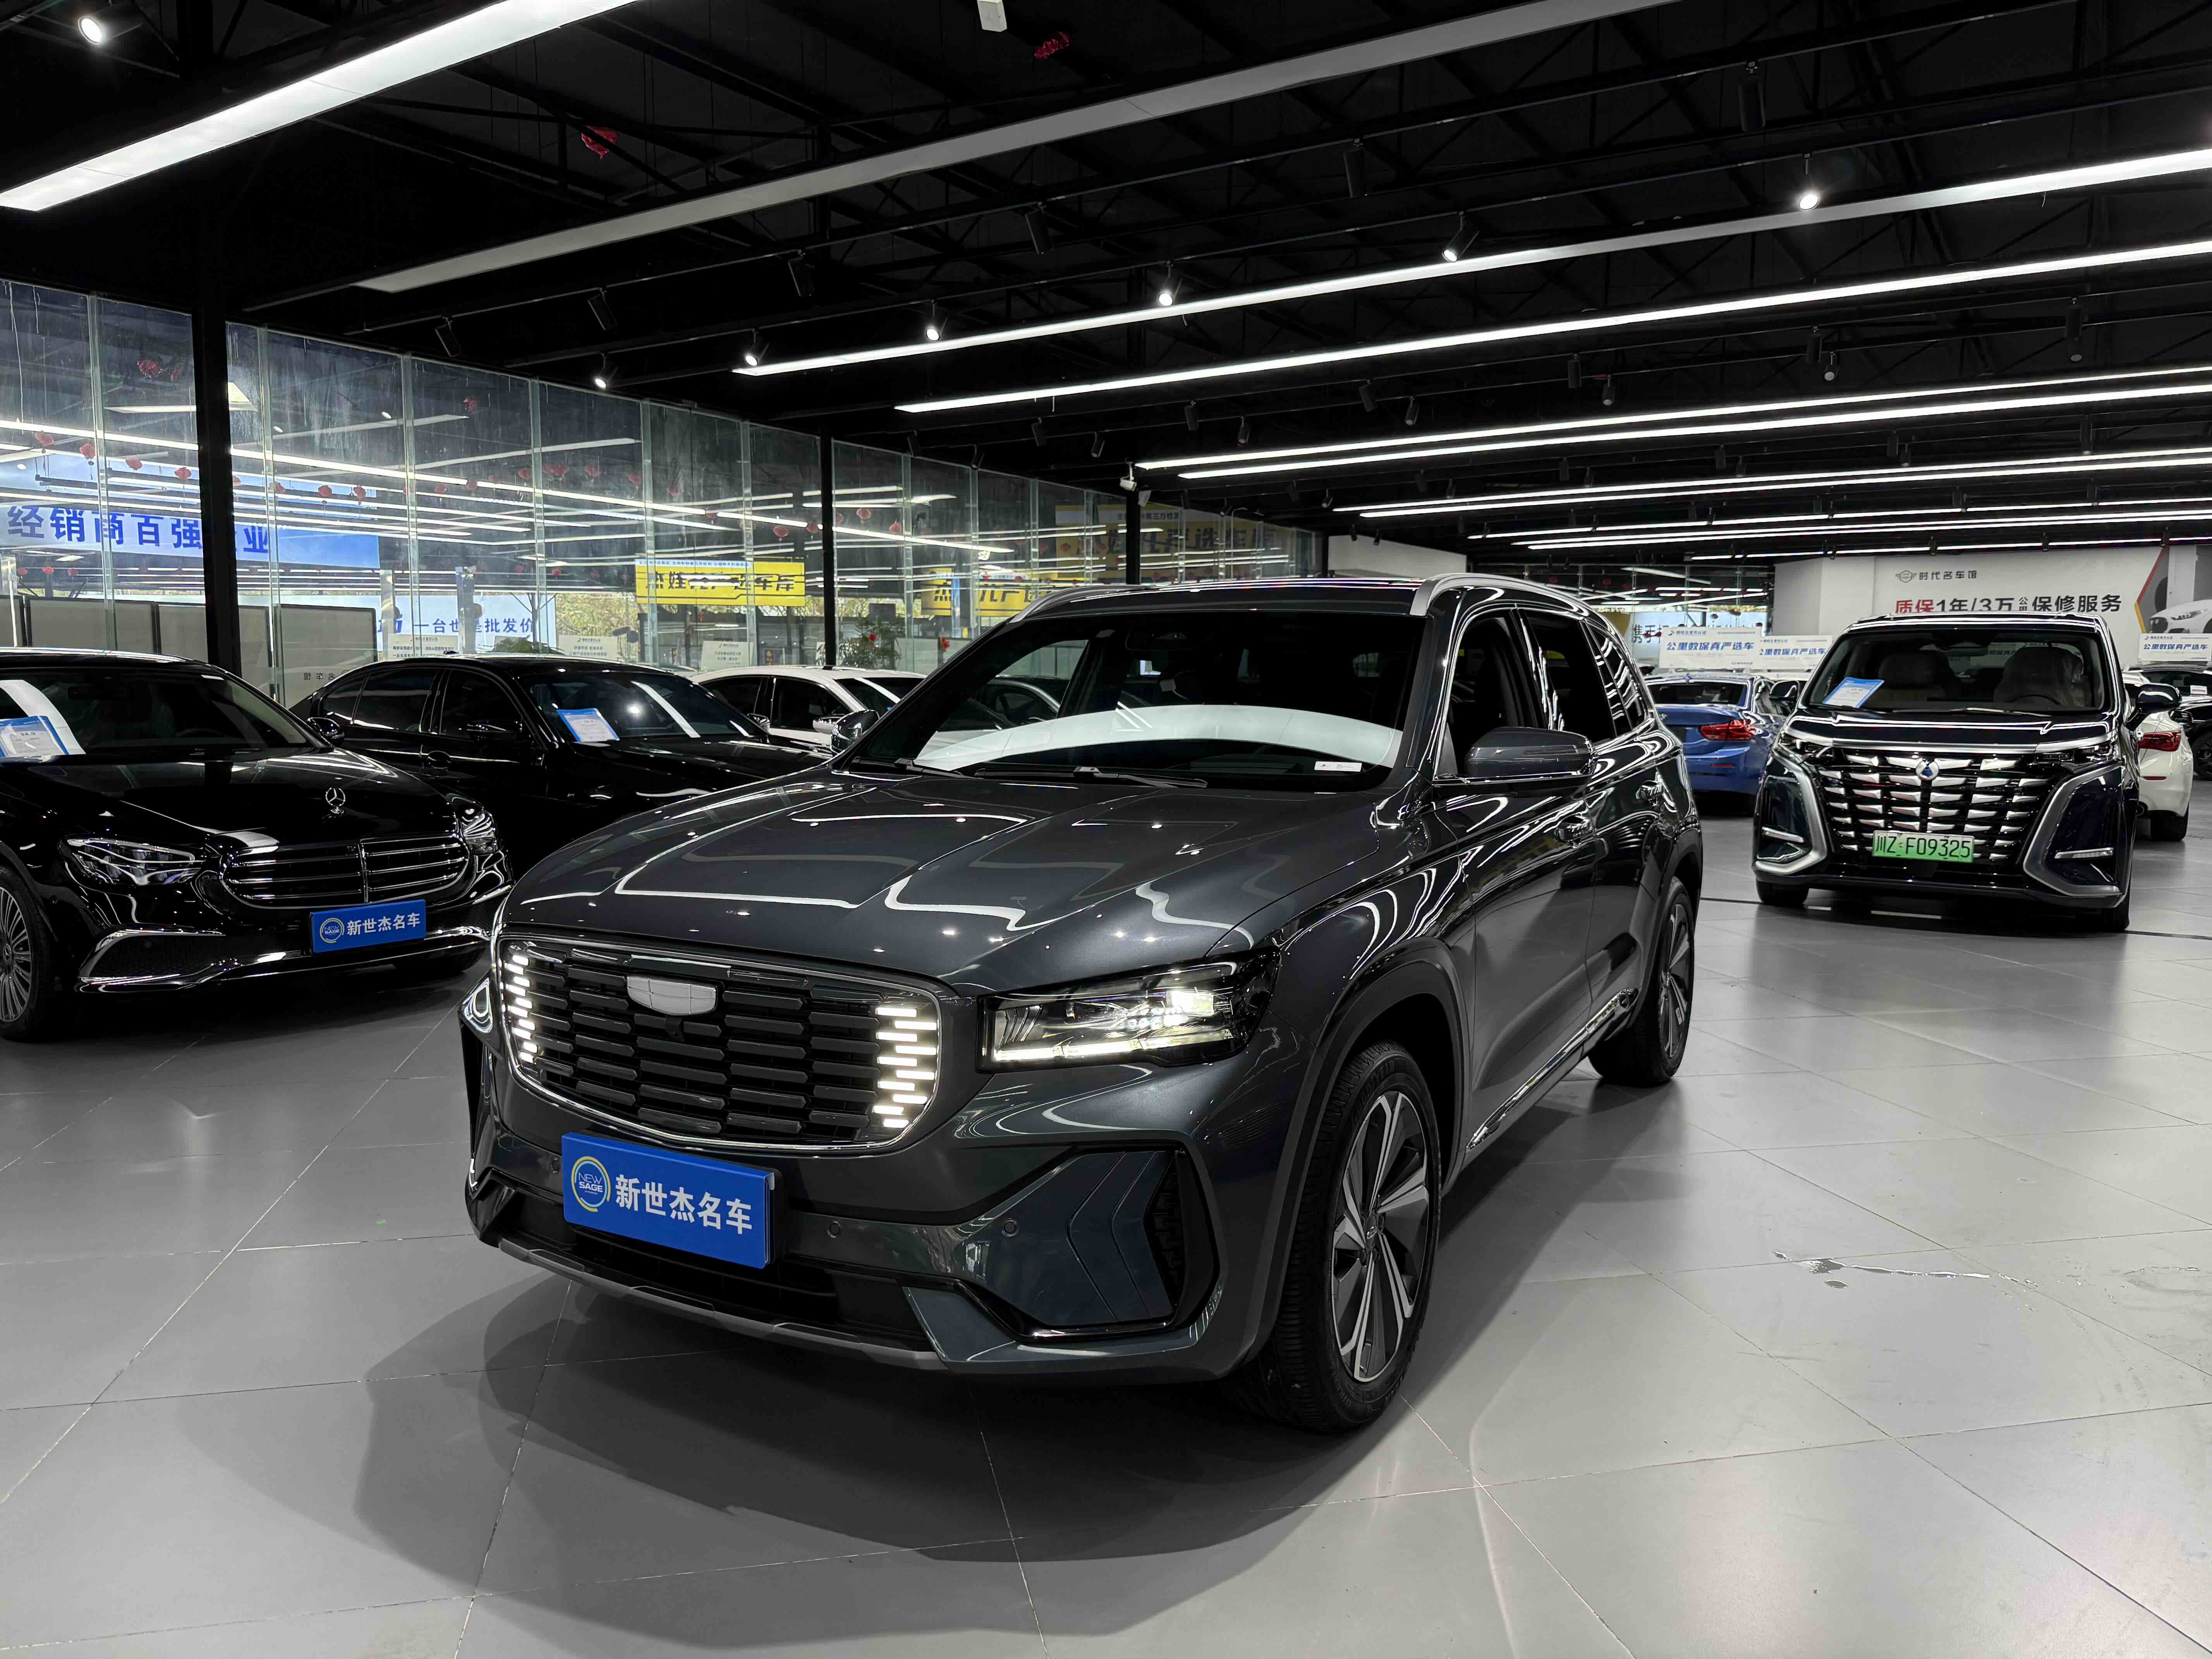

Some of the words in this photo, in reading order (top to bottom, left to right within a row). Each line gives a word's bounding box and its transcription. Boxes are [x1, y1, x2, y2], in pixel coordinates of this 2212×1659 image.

[7, 505, 268, 553] 经销商百强业
[1919, 570, 1977, 580] 时代名车馆
[347, 912, 421, 936] 新世杰名车
[579, 1172, 602, 1184] NEW
[579, 1181, 603, 1192] SAGE
[615, 1174, 752, 1235] 新世杰名车
